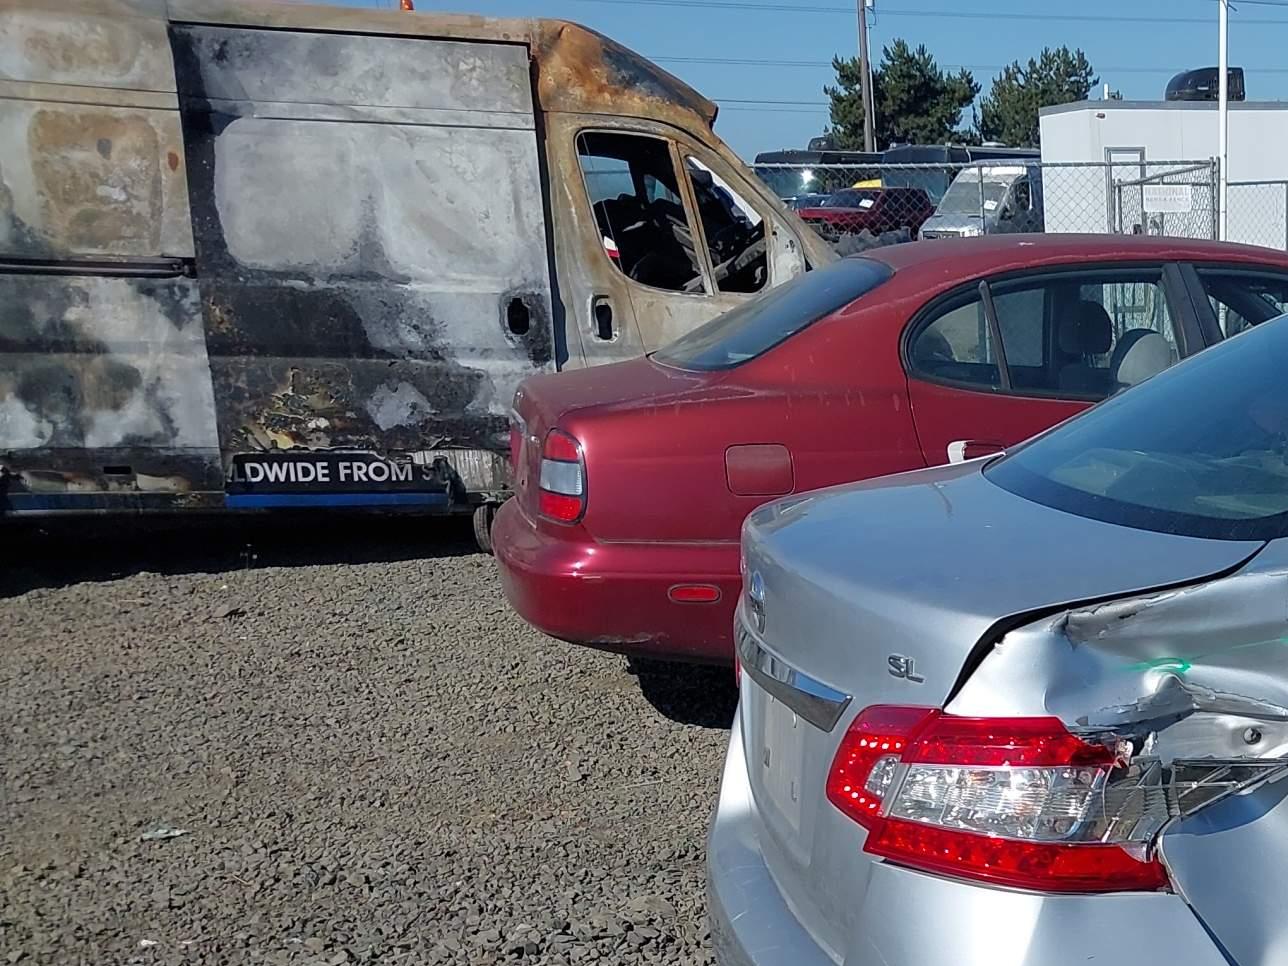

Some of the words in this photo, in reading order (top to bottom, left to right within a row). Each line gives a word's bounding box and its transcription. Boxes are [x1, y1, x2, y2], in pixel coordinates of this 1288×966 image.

[227, 461, 330, 483] LDWIDE
[338, 461, 413, 482] FROM
[887, 653, 924, 684] SL
